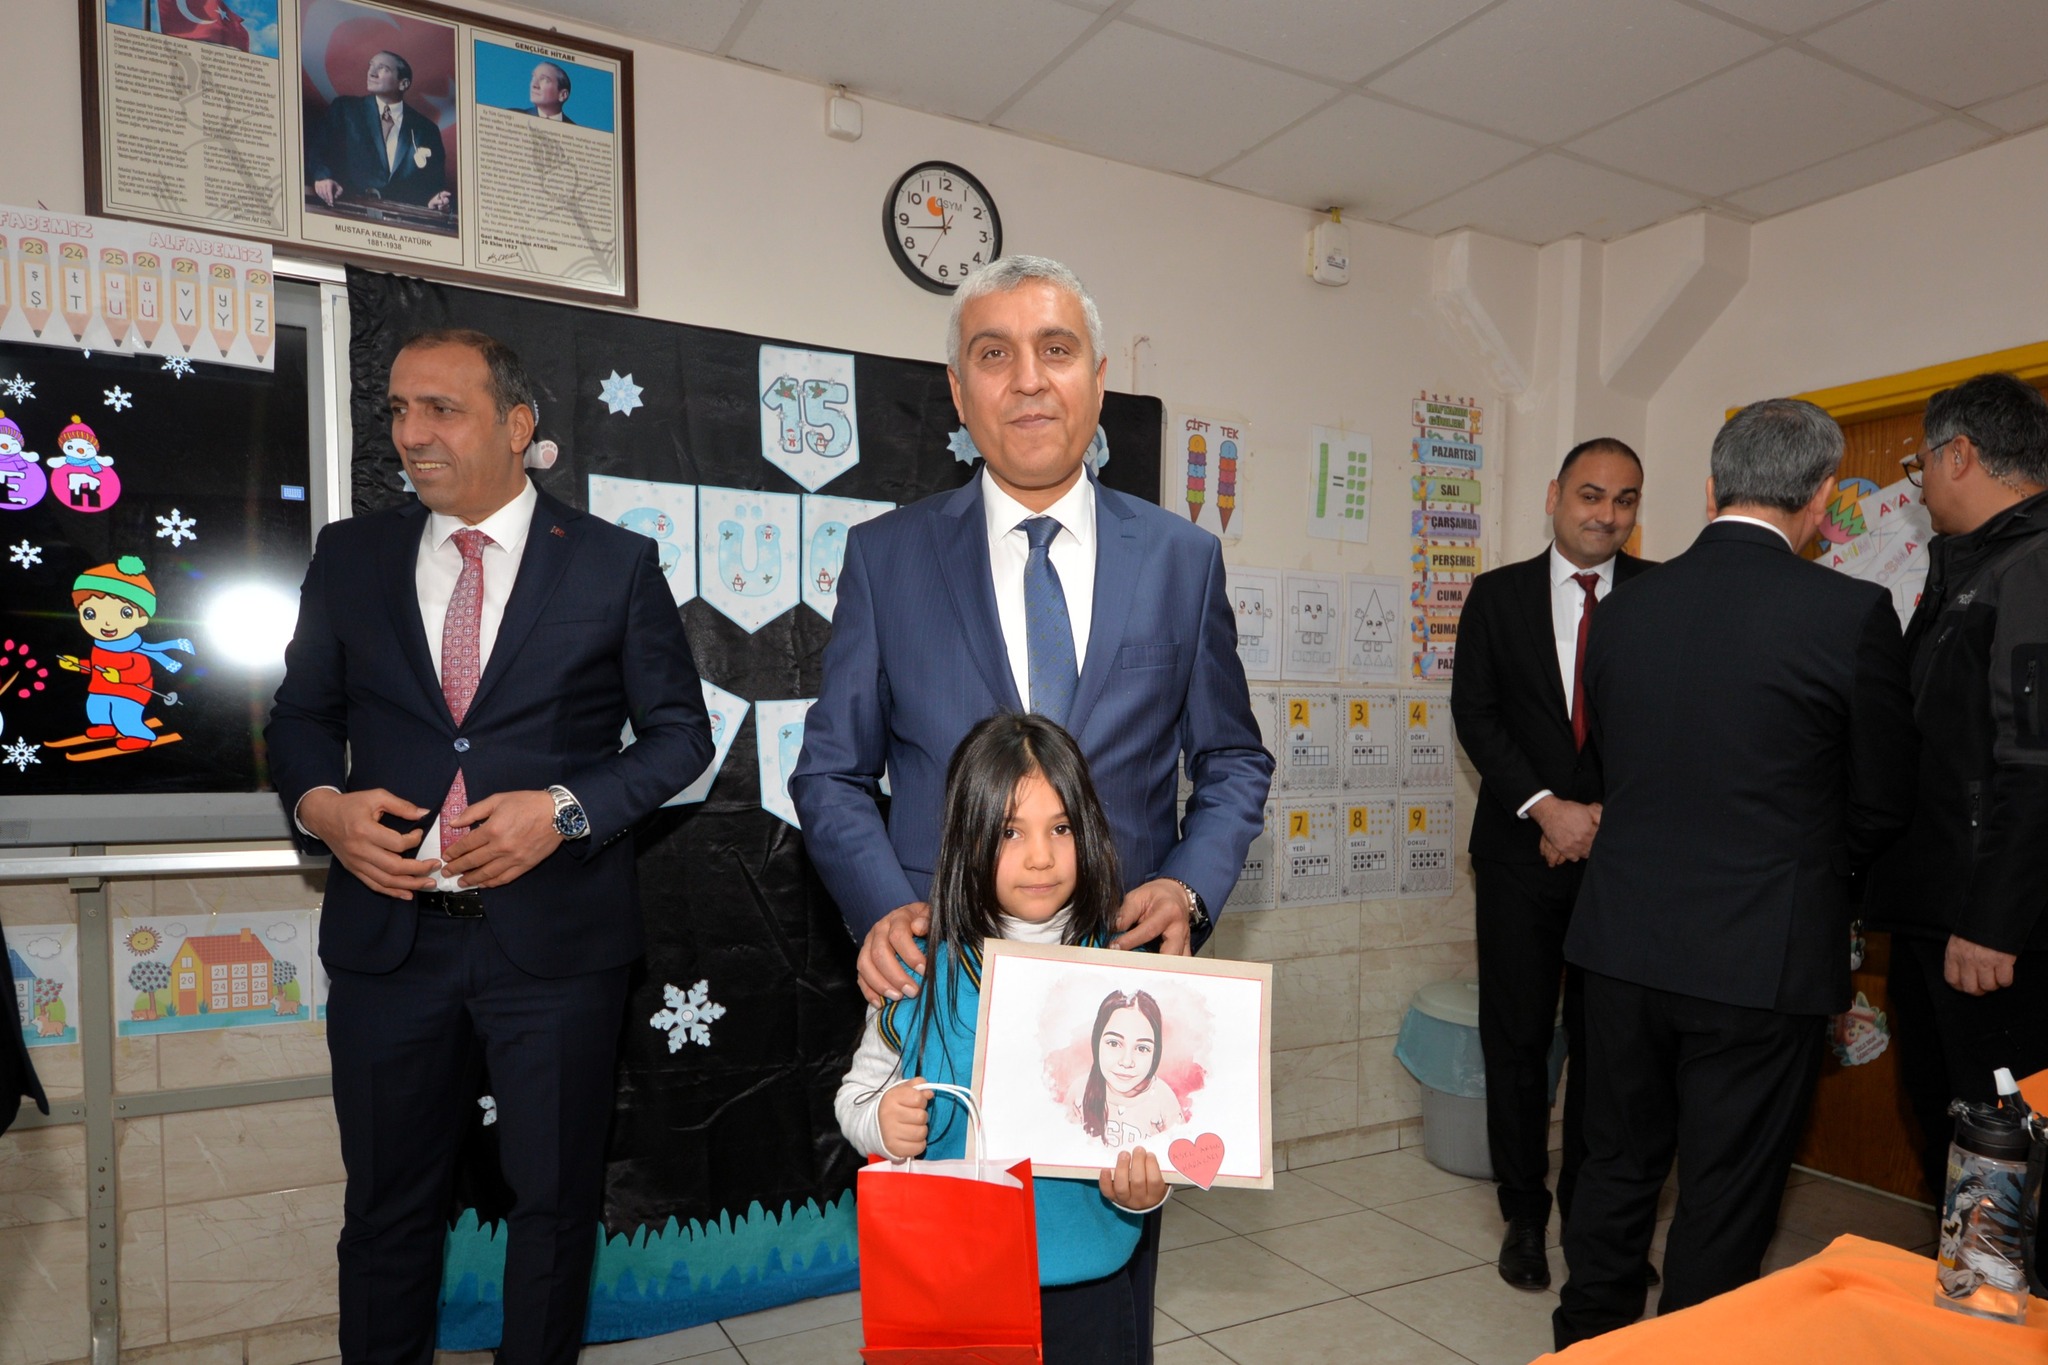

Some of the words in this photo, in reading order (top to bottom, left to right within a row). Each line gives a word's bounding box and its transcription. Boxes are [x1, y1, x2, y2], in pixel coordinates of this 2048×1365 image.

[515, 42, 548, 55] GENÇLİĞE
[550, 51, 576, 62] HİTABE
[922, 180, 930, 193] 11
[939, 177, 952, 192] 12
[908, 191, 922, 205] 10
[898, 213, 910, 226] 9
[972, 207, 982, 220] 2
[335, 224, 370, 236] MUSTAFA
[372, 230, 398, 242] KEMAL
[400, 235, 432, 247] ATATÜRK
[979, 230, 988, 243] 3
[24, 242, 43, 254] 23
[368, 238, 402, 250] 1881-1938
[904, 236, 915, 250] 8
[64, 247, 84, 260] 24
[105, 252, 124, 266] 25
[972, 252, 982, 264] 4
[138, 256, 156, 268] 26
[176, 261, 194, 273] 27
[918, 254, 928, 268] 7
[214, 267, 231, 280] 28
[938, 264, 948, 278] 6
[960, 263, 968, 276] 5
[72, 272, 78, 284] t
[250, 272, 267, 284] 29
[31, 291, 42, 308] Ş
[70, 295, 82, 310] T
[218, 294, 227, 307] y
[109, 300, 122, 315] U
[141, 300, 154, 318] Ü
[180, 307, 192, 322] V
[218, 312, 230, 326] Y
[254, 318, 265, 333] Z
[762, 376, 852, 458] 15
[1186, 418, 1210, 432] ÇİFT
[1220, 426, 1239, 440] TEK
[1432, 445, 1476, 462] PAZARTESİ
[1440, 484, 1460, 496] SALI
[1431, 516, 1477, 532] ÇARŞAMBA
[1432, 554, 1476, 568] PERŞEMBE
[1437, 590, 1462, 602] CUMA
[1430, 624, 1458, 635] CUMA
[1438, 658, 1454, 670] PAZ
[1293, 703, 1303, 720] 2
[1354, 704, 1364, 721] 3
[1412, 704, 1421, 720] 4
[1294, 816, 1303, 832] 7
[1353, 810, 1362, 828] 8
[1412, 810, 1422, 826] 9
[1292, 844, 1306, 852] YEDİ
[214, 968, 224, 976] 21
[234, 966, 246, 974] 22
[254, 965, 266, 974] 23
[181, 976, 194, 984] 20
[214, 983, 226, 991] 24
[234, 982, 246, 990] 25
[254, 980, 266, 988] 26
[214, 998, 226, 1006] 27
[234, 996, 246, 1004] 28
[254, 995, 266, 1003] 29
